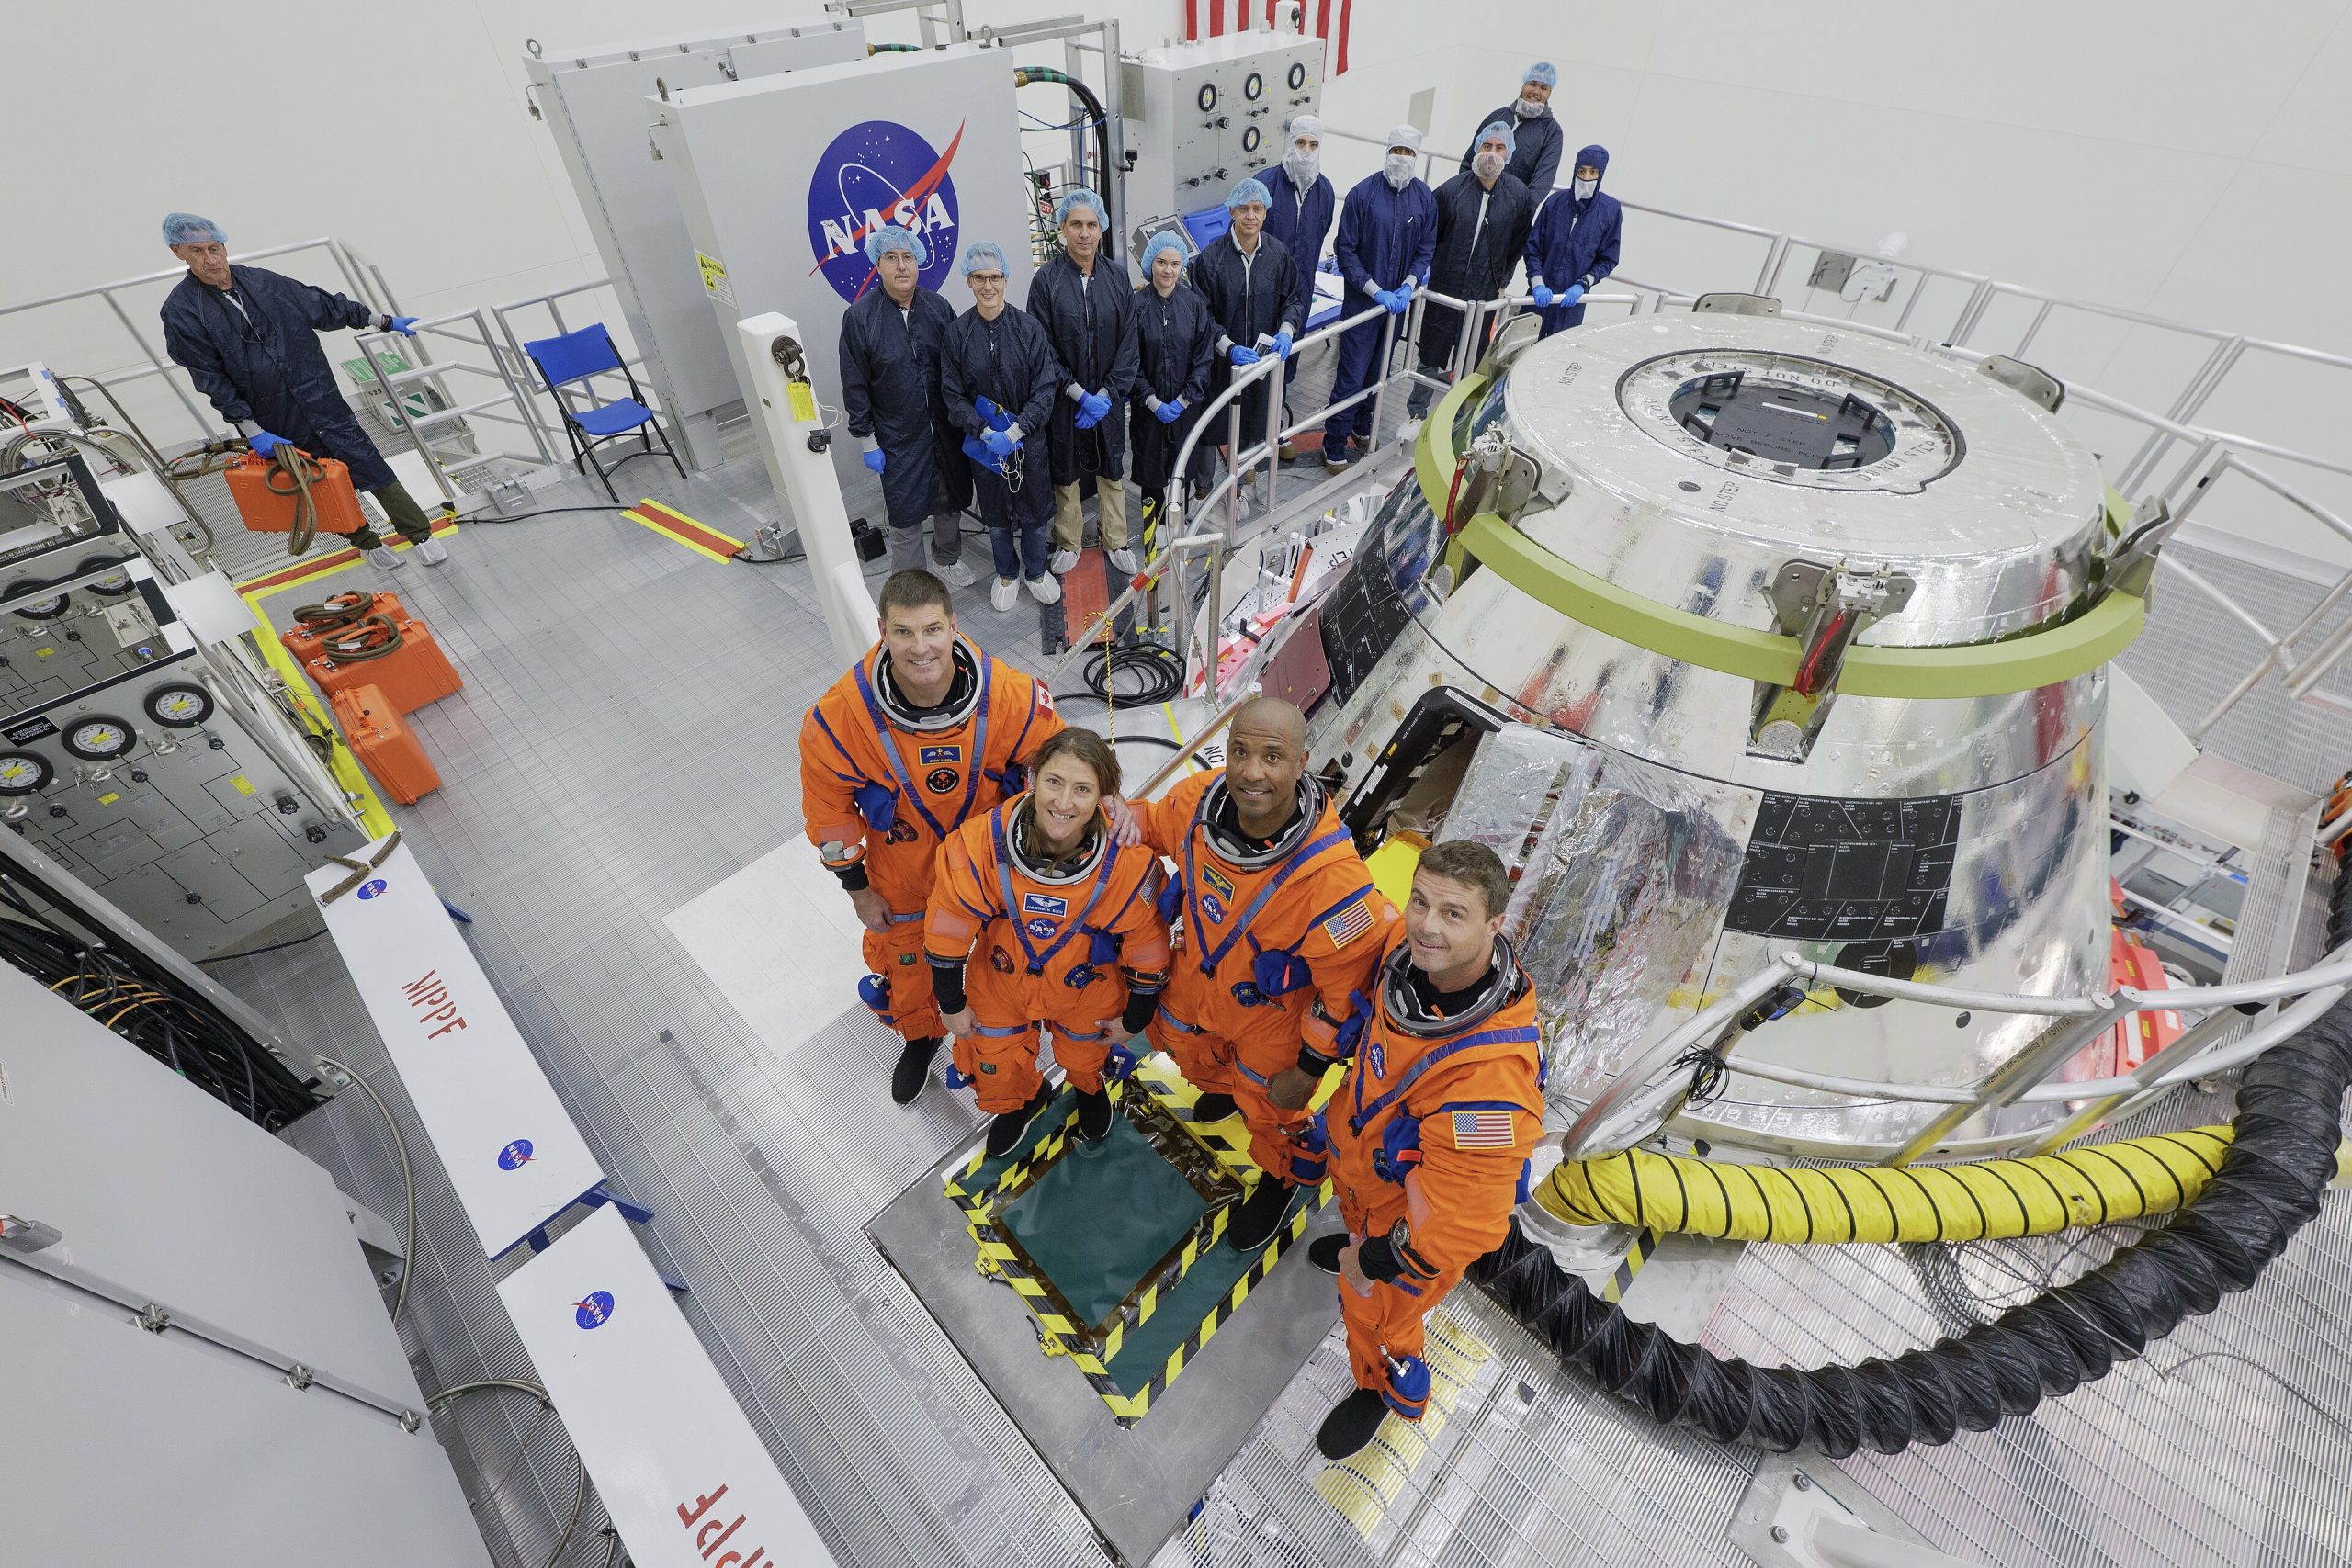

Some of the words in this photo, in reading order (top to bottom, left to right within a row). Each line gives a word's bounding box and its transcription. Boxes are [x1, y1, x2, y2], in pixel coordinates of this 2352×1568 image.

[820, 193, 956, 260] NASA
[1565, 362, 1582, 378] STEP
[1558, 376, 1574, 386] NO
[1715, 432, 1744, 441] MOVE
[1856, 469, 1881, 482] DO
[1904, 441, 1938, 457] STEP
[1717, 480, 1740, 501] STEP
[1709, 500, 1729, 512] NO
[1204, 746, 1225, 763] NO
[402, 969, 467, 1040] MPPF
[677, 1483, 775, 1568] PF
